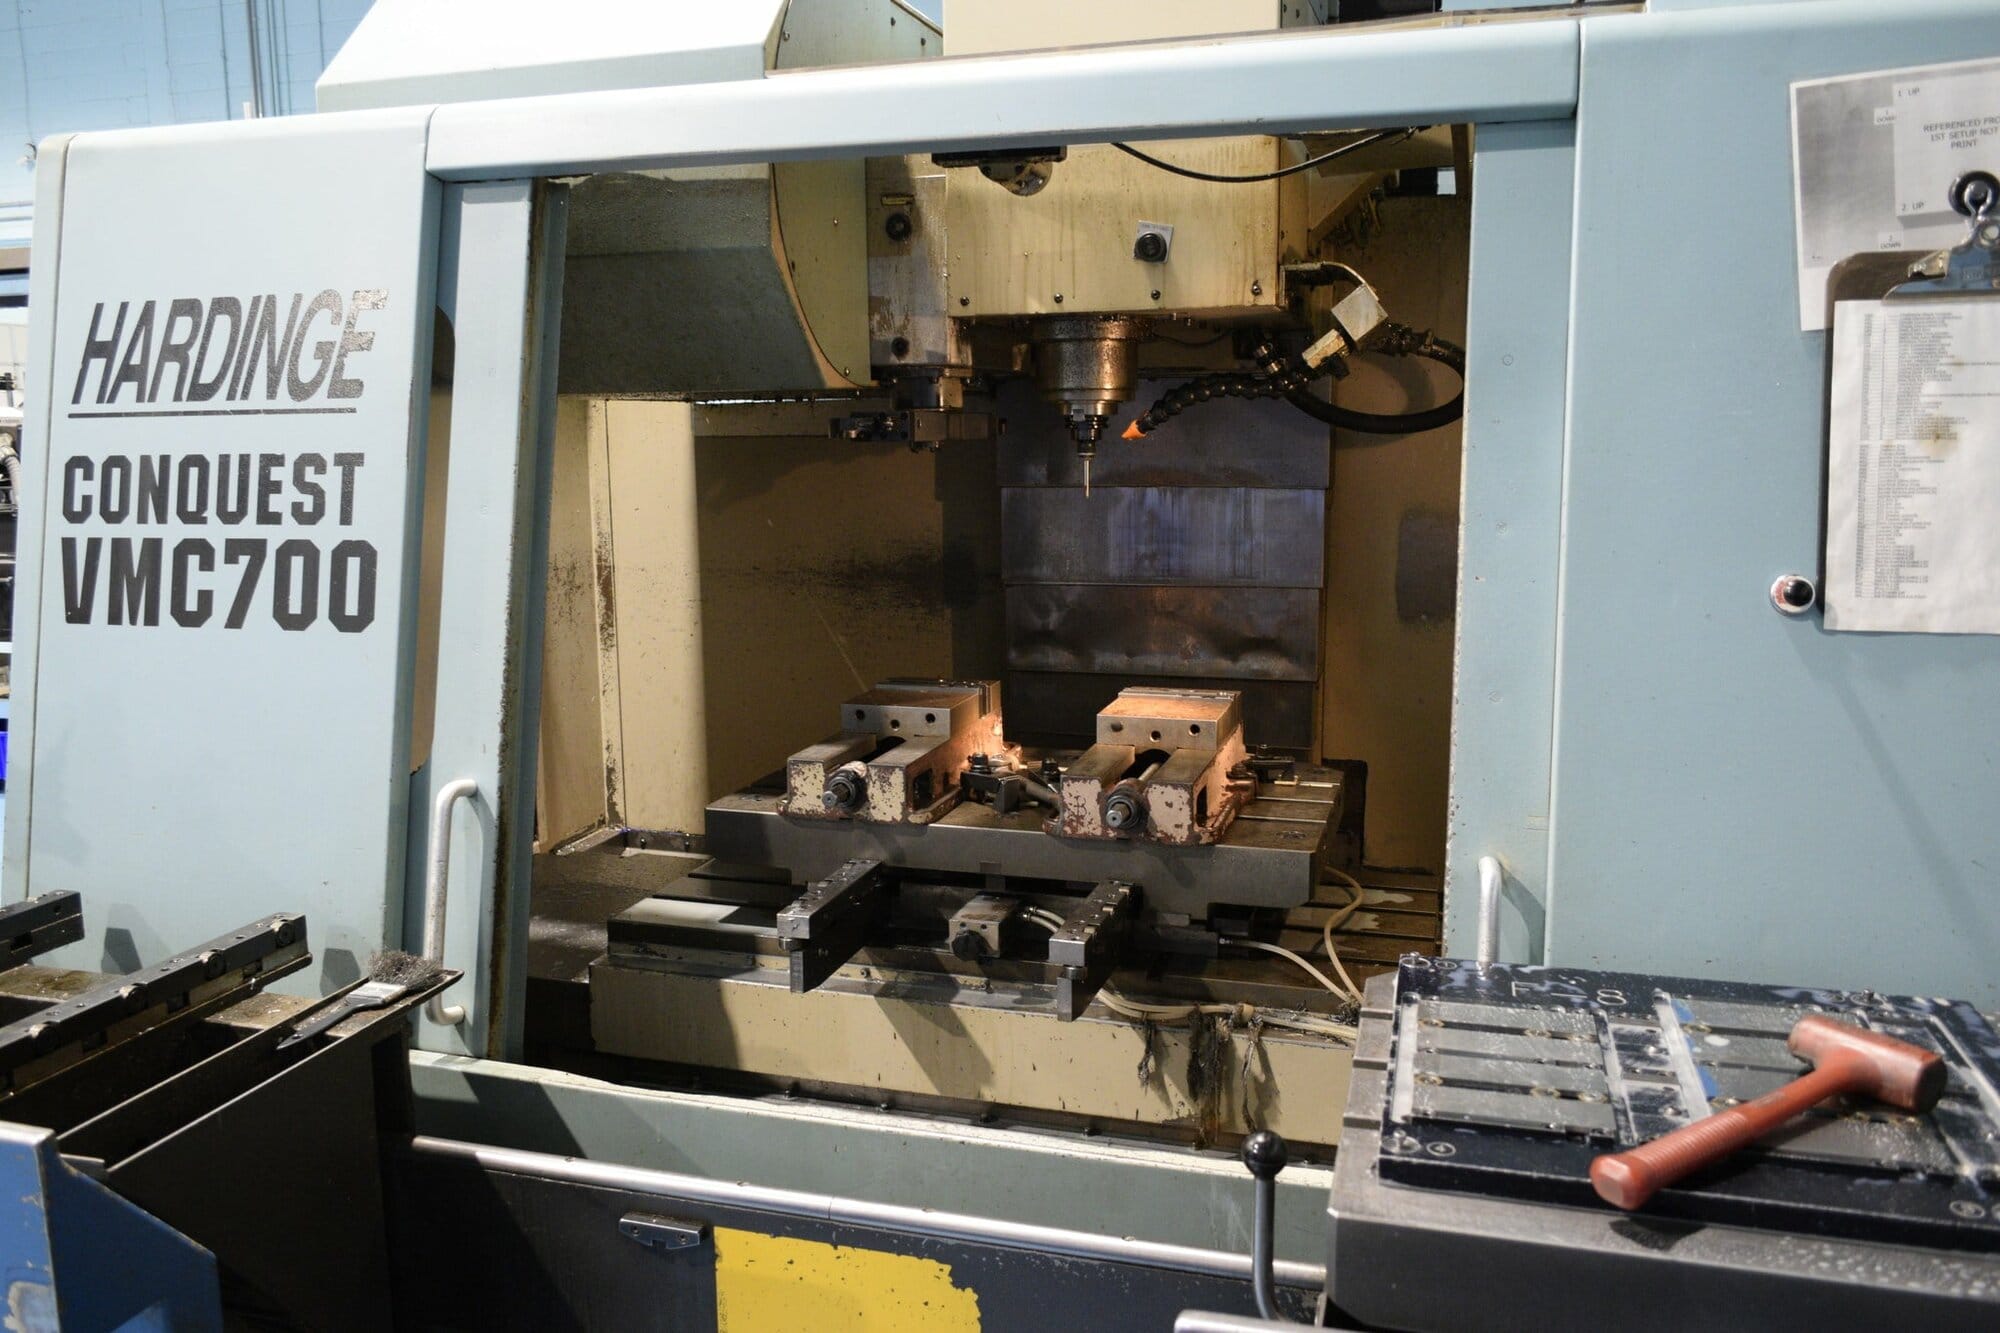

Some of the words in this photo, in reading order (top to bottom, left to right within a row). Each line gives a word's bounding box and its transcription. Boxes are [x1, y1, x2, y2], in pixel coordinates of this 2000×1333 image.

[1908, 87, 1920, 96] UP
[1923, 118, 1981, 132] REFERENCED
[1930, 132, 1946, 142] 1ST
[1949, 129, 1977, 140] SETUP
[1980, 126, 1998, 136] NOT
[1950, 139, 1977, 149] PRINT
[1912, 201, 1924, 210] UP
[71, 288, 390, 405] HARDINGE
[61, 452, 366, 526] CONQUEST
[60, 536, 379, 634] VMC700
